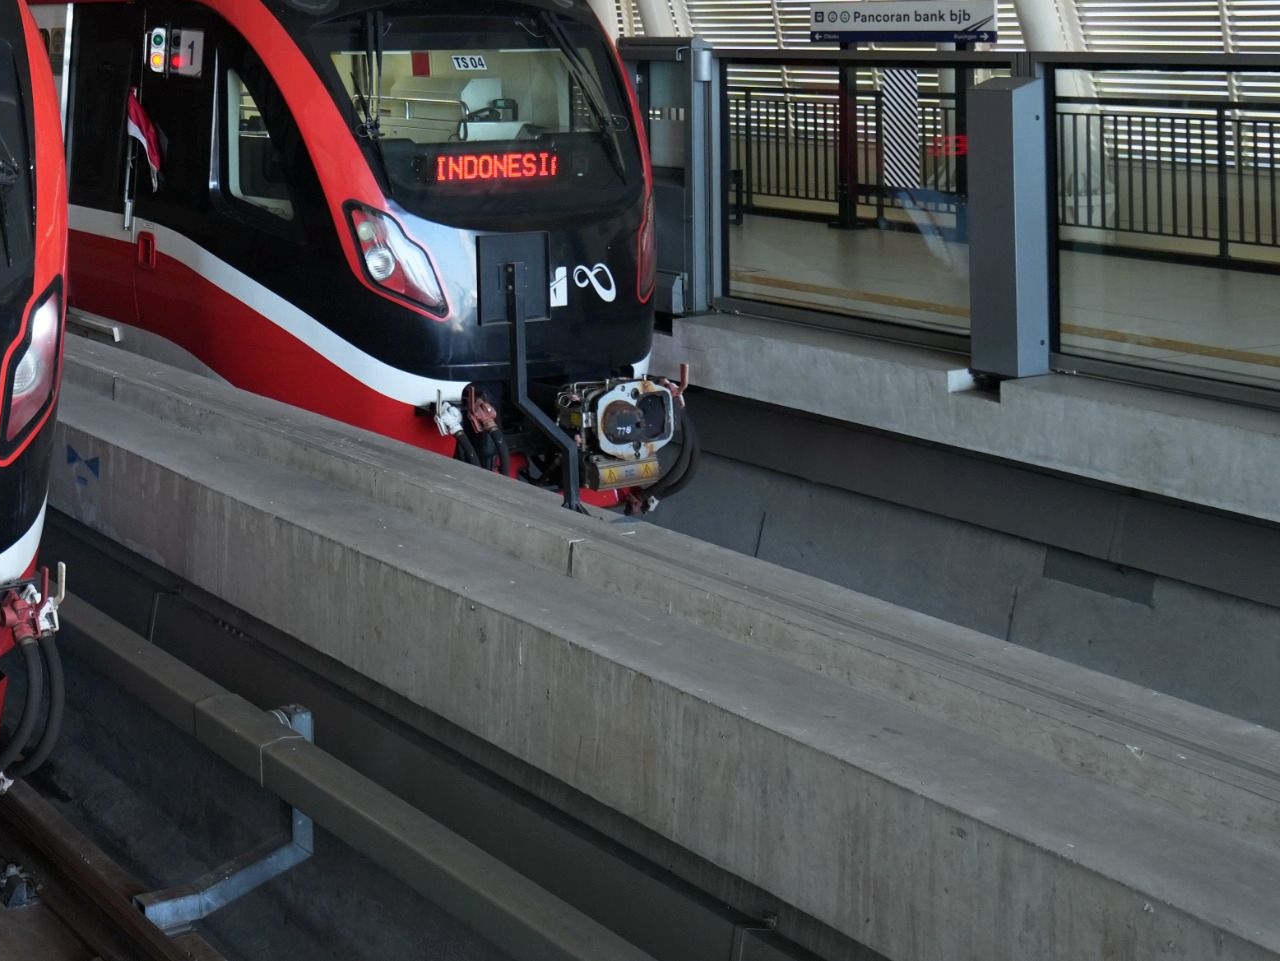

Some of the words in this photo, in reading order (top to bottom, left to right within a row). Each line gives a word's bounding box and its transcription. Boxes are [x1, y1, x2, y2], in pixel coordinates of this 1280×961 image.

[853, 11, 910, 23] Pancoran
[914, 10, 946, 23] bank
[950, 9, 971, 25] bjb
[187, 41, 195, 66] 1
[453, 57, 470, 69] TS
[470, 57, 485, 69] 04
